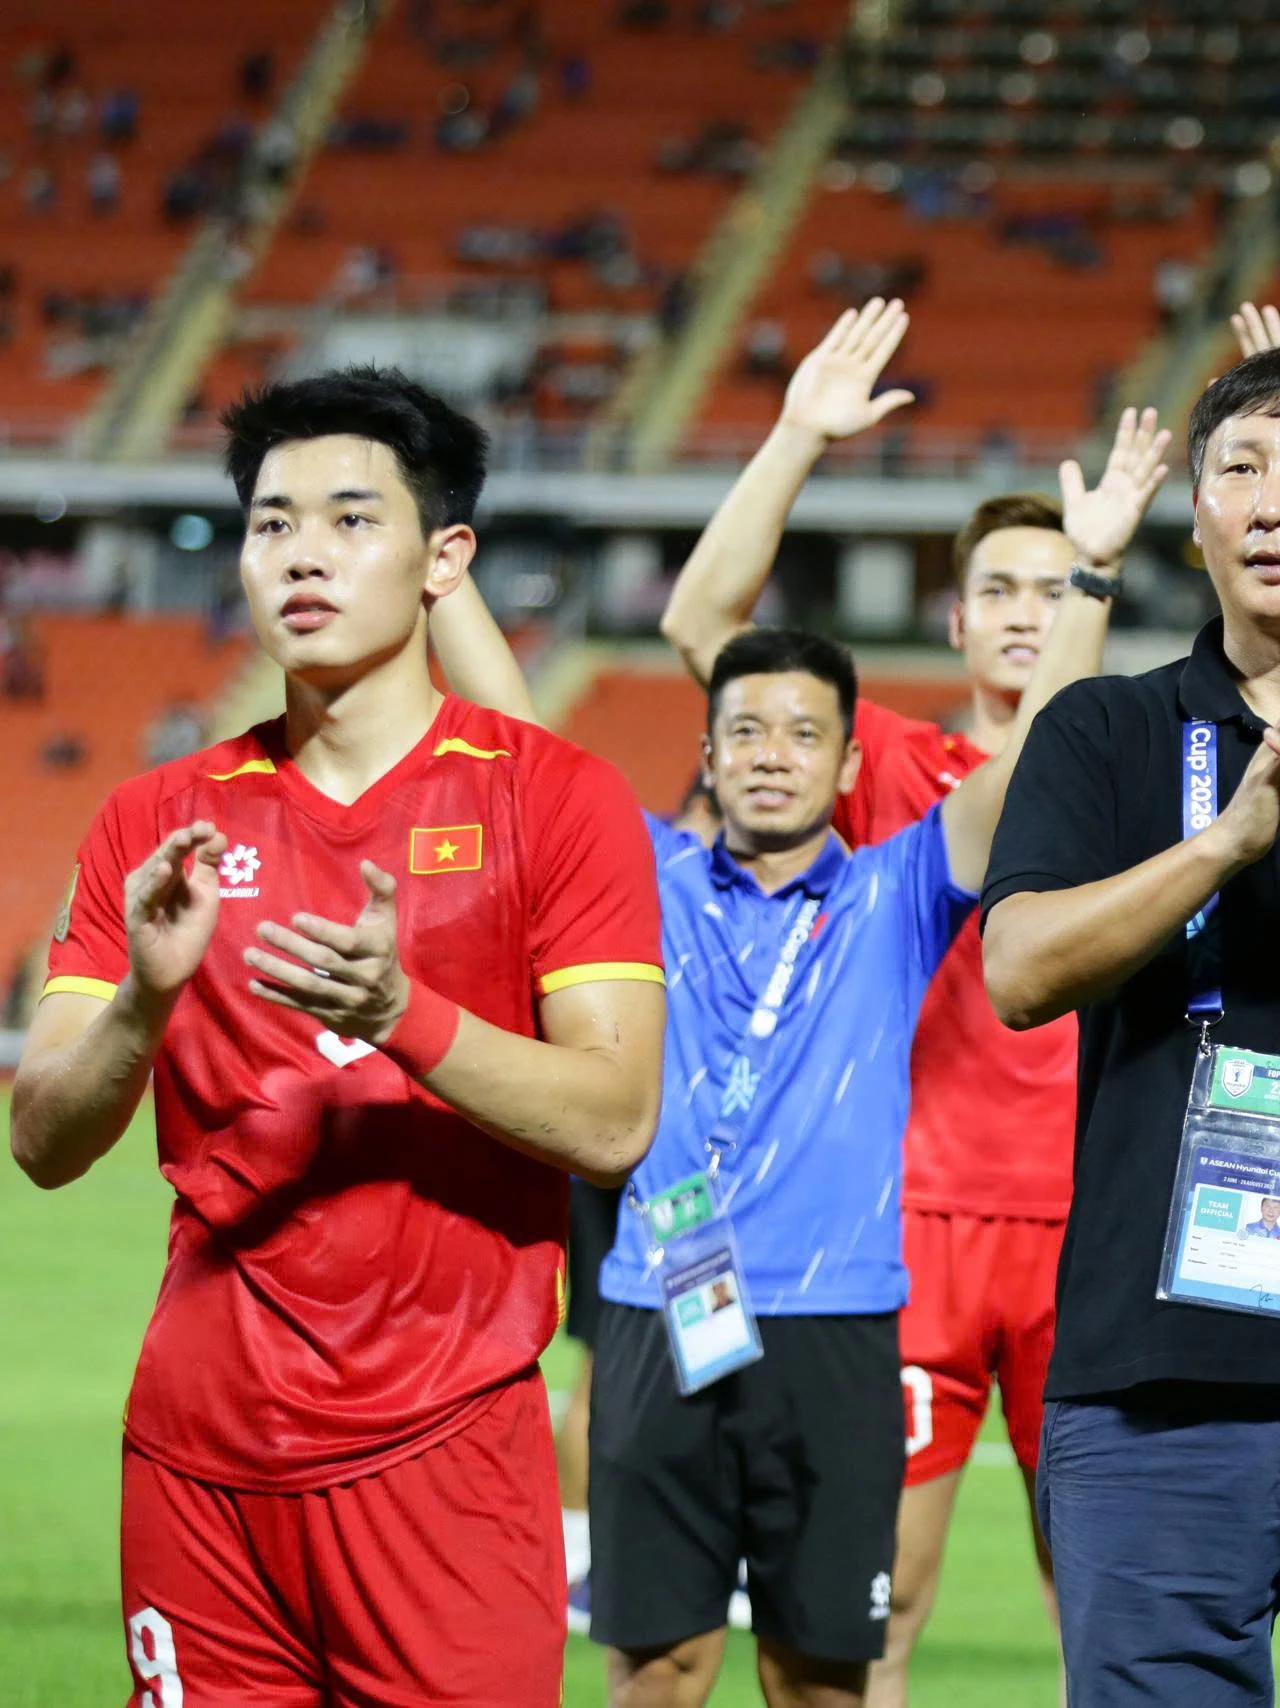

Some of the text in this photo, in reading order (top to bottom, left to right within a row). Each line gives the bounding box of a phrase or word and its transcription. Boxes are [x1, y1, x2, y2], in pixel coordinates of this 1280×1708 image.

[1186, 727, 1212, 771] Cup
[1190, 774, 1212, 830] 2026
[1208, 1159, 1236, 1169] ASEAN
[1236, 1163, 1269, 1175] Hyundai
[1200, 1207, 1233, 1218] OFFICIAL
[1208, 1200, 1230, 1210] TEAM
[129, 1606, 184, 1708] 9
